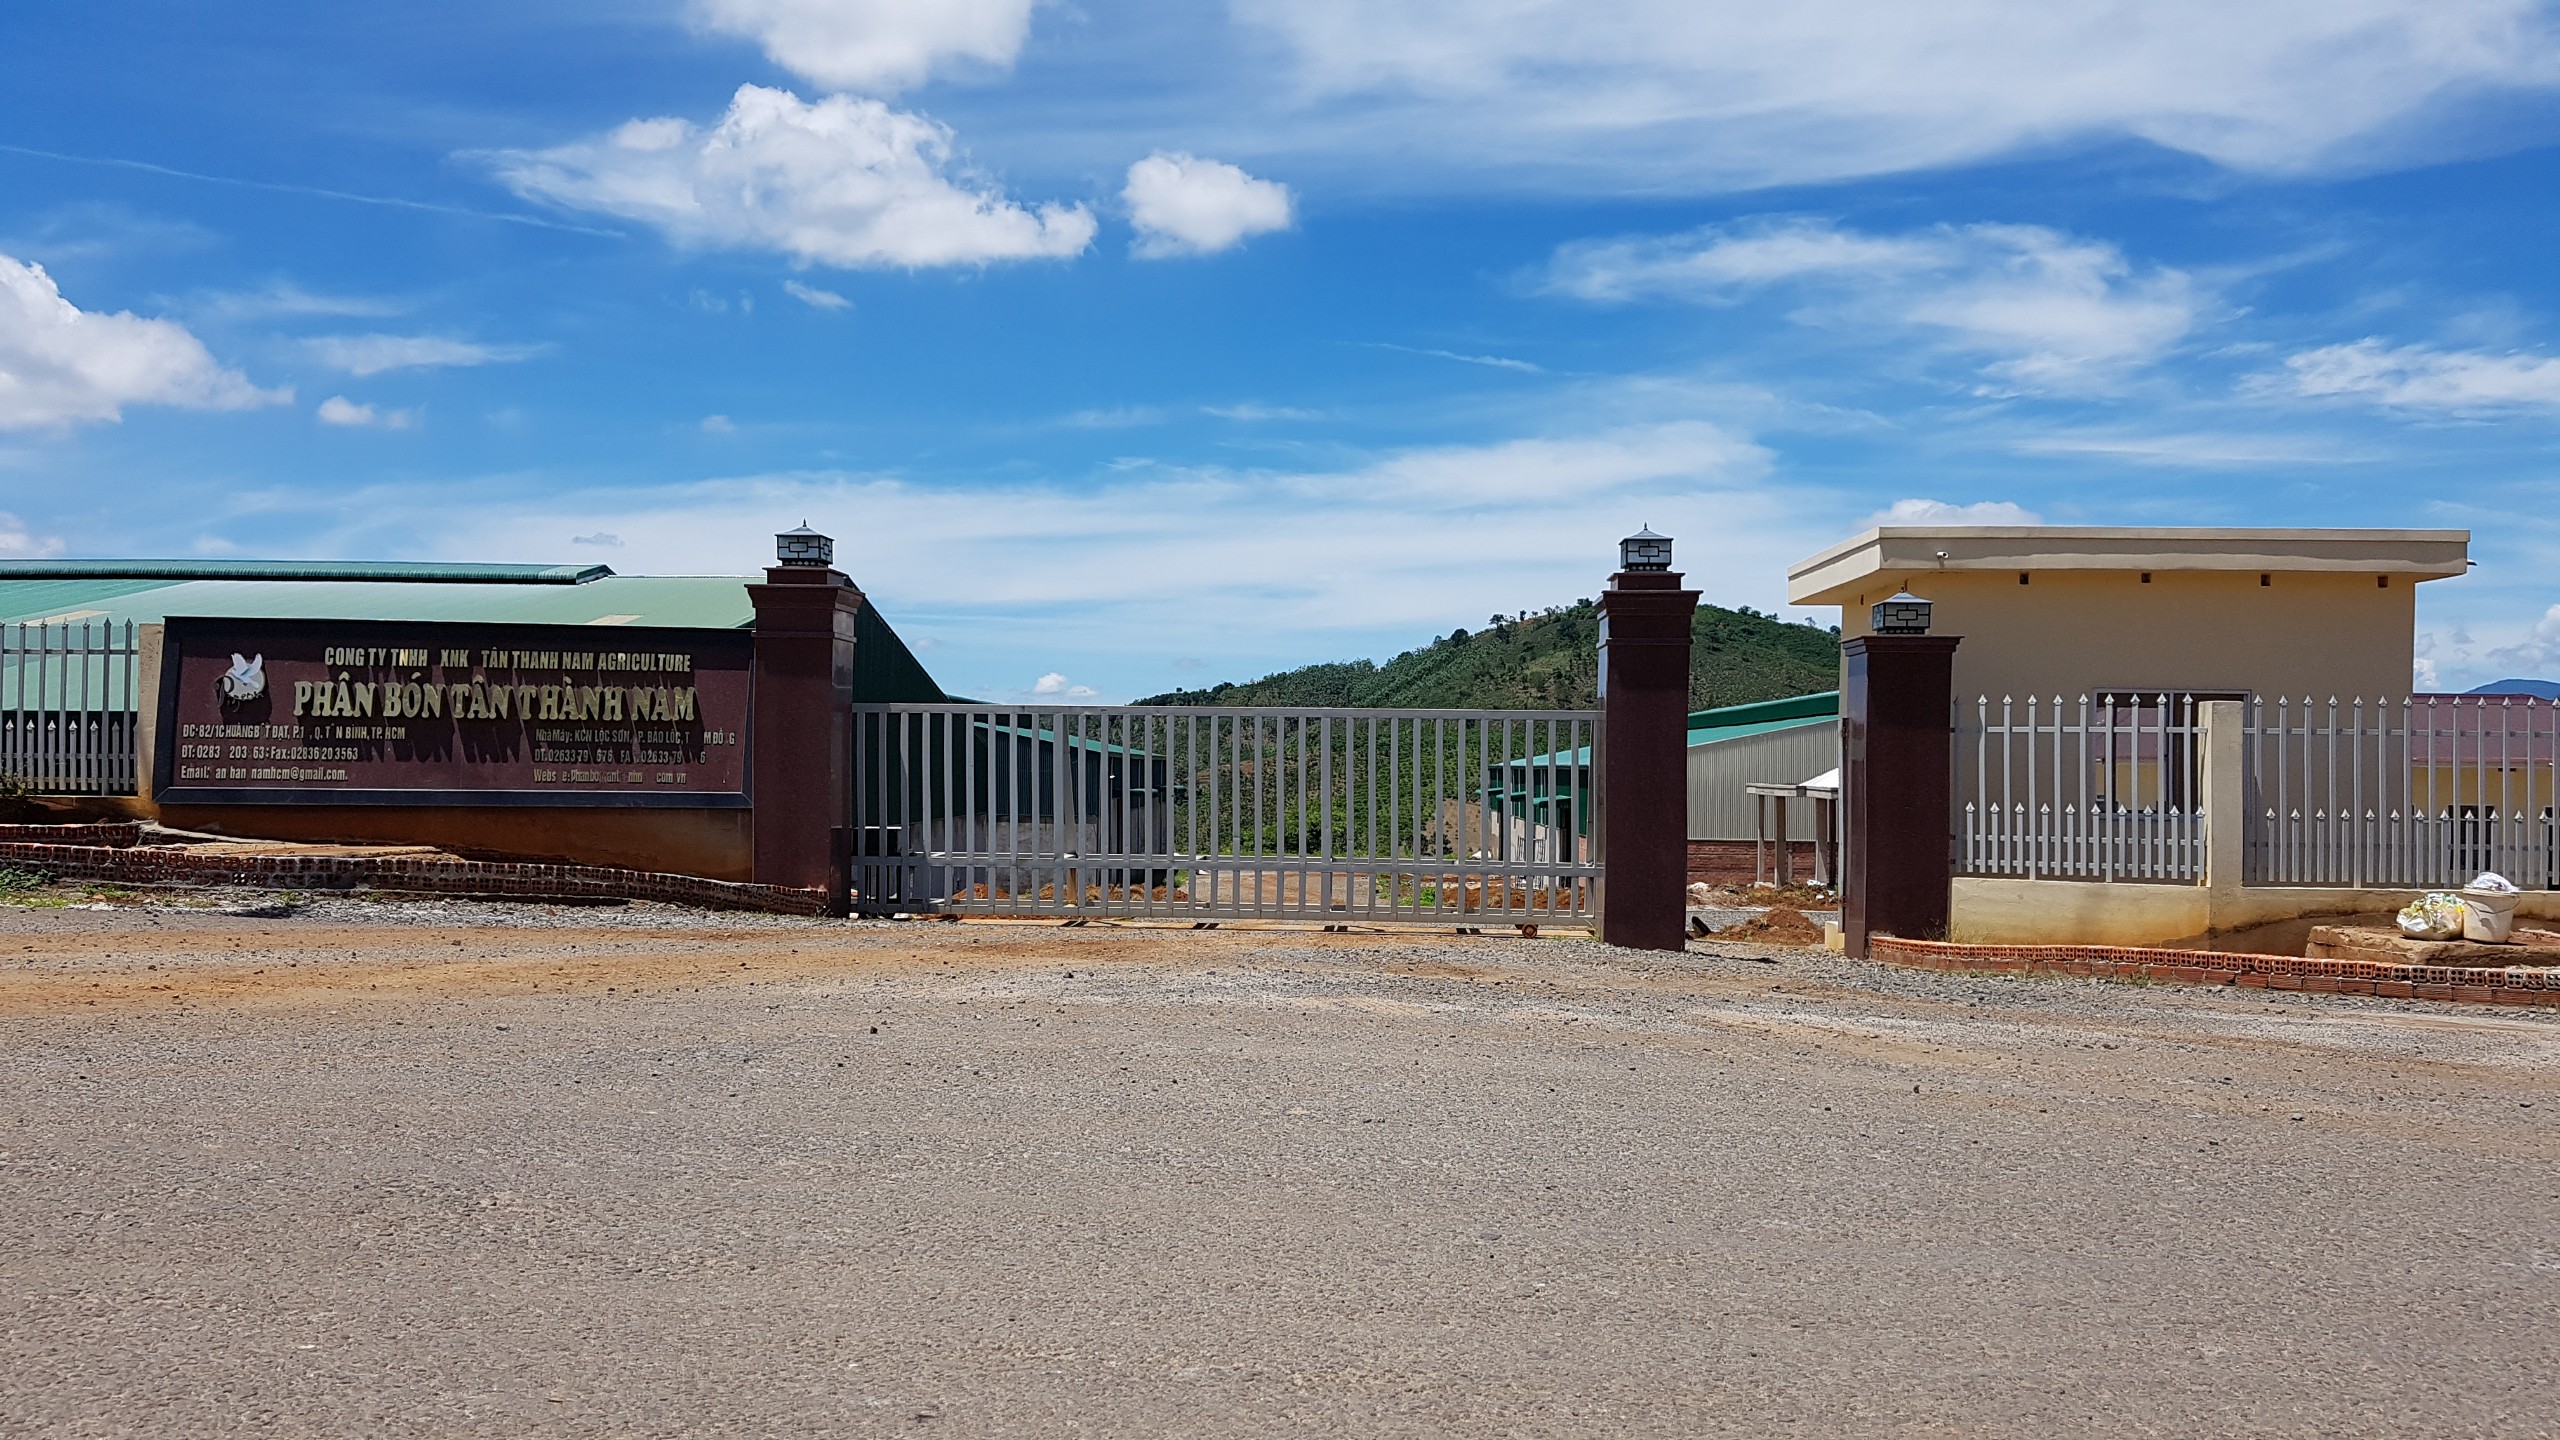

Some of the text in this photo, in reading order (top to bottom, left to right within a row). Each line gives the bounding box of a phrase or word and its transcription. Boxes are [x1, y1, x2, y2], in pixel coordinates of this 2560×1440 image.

[368, 648, 387, 667] TY
[391, 648, 428, 668] TNHH
[440, 649, 469, 668] XNK
[481, 646, 509, 669] TÂN
[562, 651, 594, 670] NAM
[598, 652, 691, 673] AGRICULTURE
[293, 671, 378, 717] PHÂN
[383, 671, 446, 718] BÓN
[451, 674, 512, 720] TÂN
[519, 675, 625, 721] THÀNH
[631, 685, 696, 722] NAM
[385, 727, 406, 740] HCM
